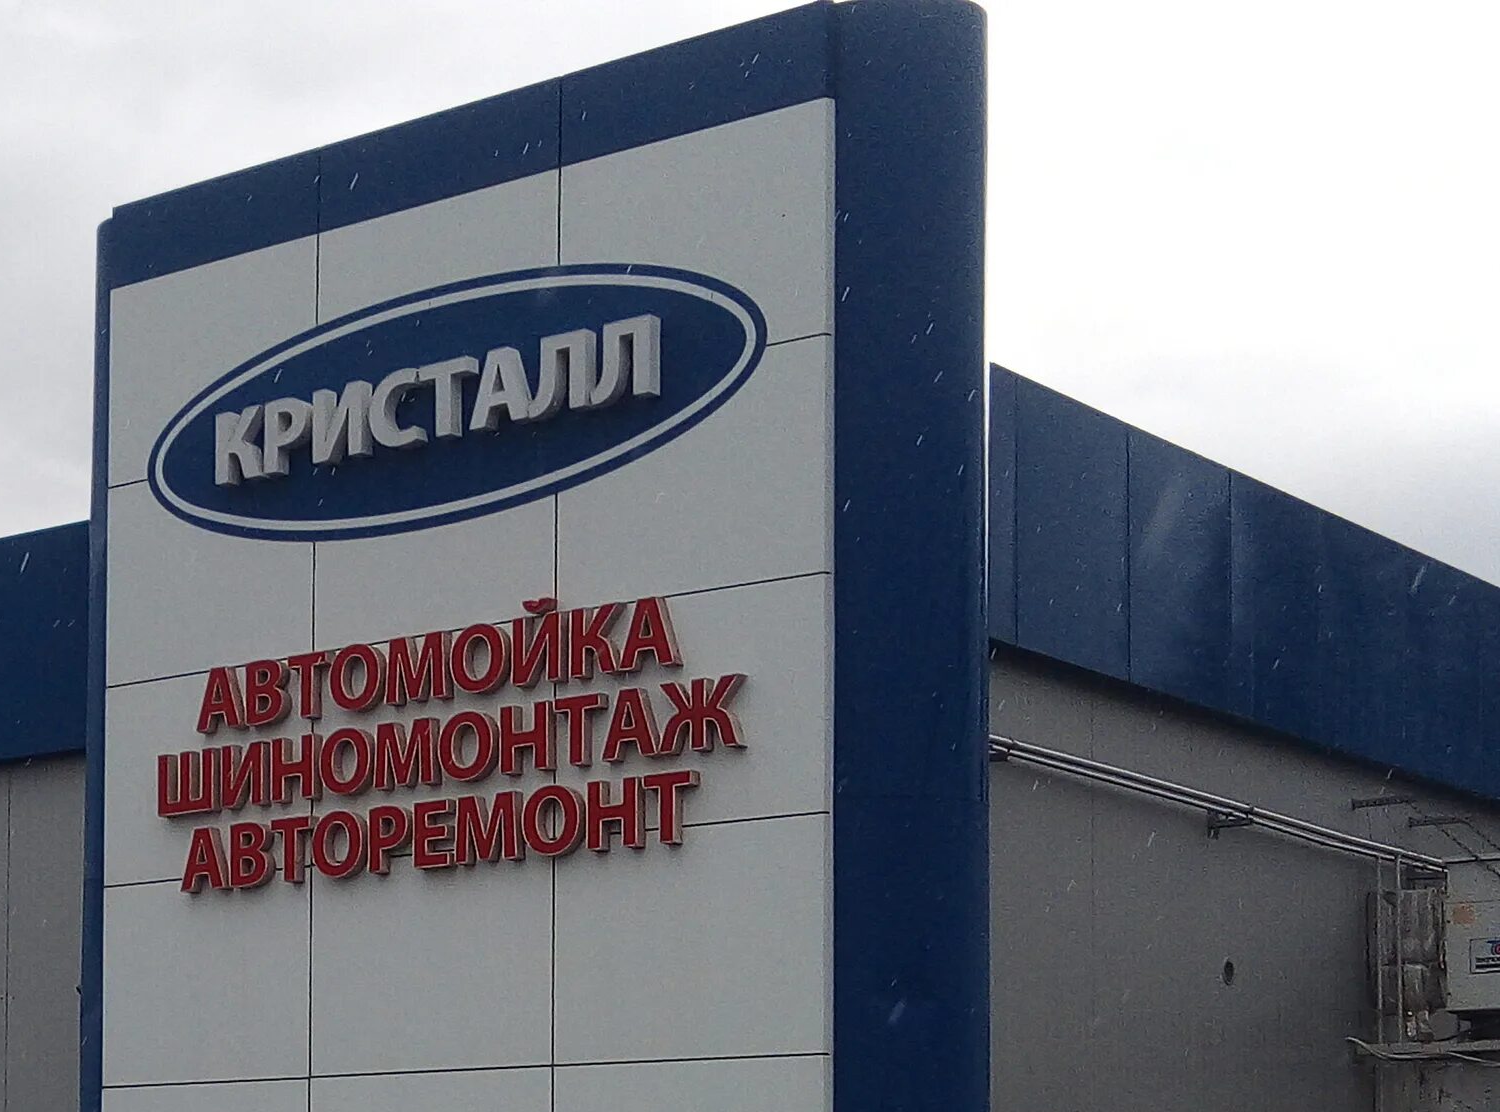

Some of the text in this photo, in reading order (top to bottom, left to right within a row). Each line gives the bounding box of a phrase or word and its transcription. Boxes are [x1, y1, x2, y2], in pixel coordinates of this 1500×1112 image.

[215, 314, 661, 485] КРИСТАЛЛ
[197, 597, 683, 734] АВТОМОЙКА
[157, 674, 748, 818] ШИНОМОНТАЖ
[181, 771, 700, 893] АВТОРЕМОНТ
